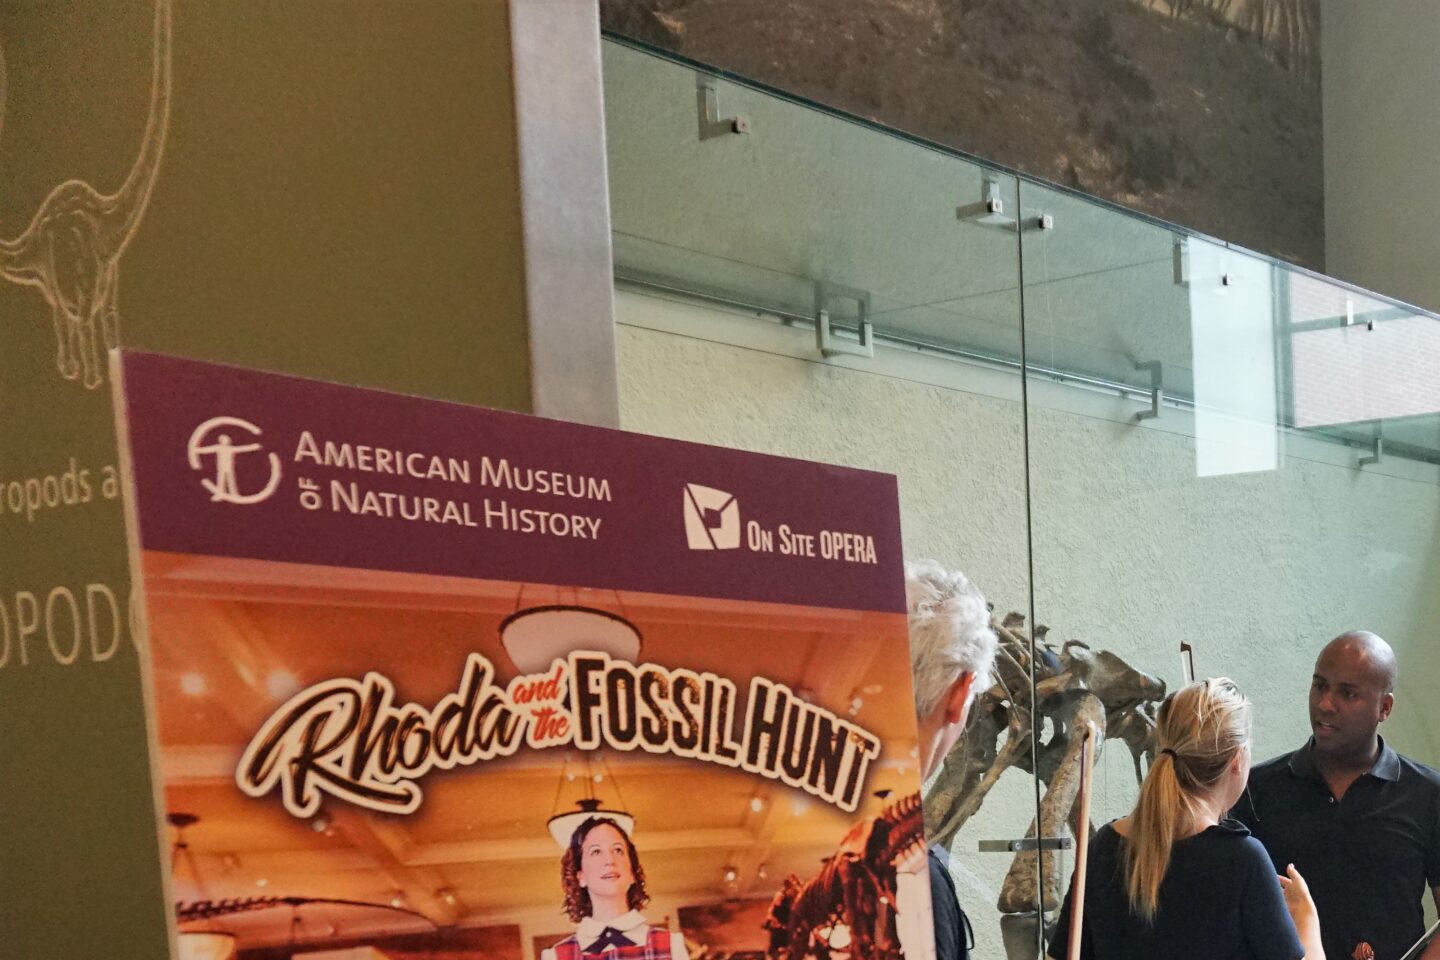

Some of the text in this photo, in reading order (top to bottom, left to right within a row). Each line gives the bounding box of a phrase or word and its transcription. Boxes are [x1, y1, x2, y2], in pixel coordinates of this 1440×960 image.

[294, 430, 612, 502] AMERICAN MUSEUM
[300, 477, 601, 540] OF NATURAL HISTORY
[820, 530, 878, 565] OPERA
[240, 655, 876, 813] Rhoda and the FOSSIL HUNT
